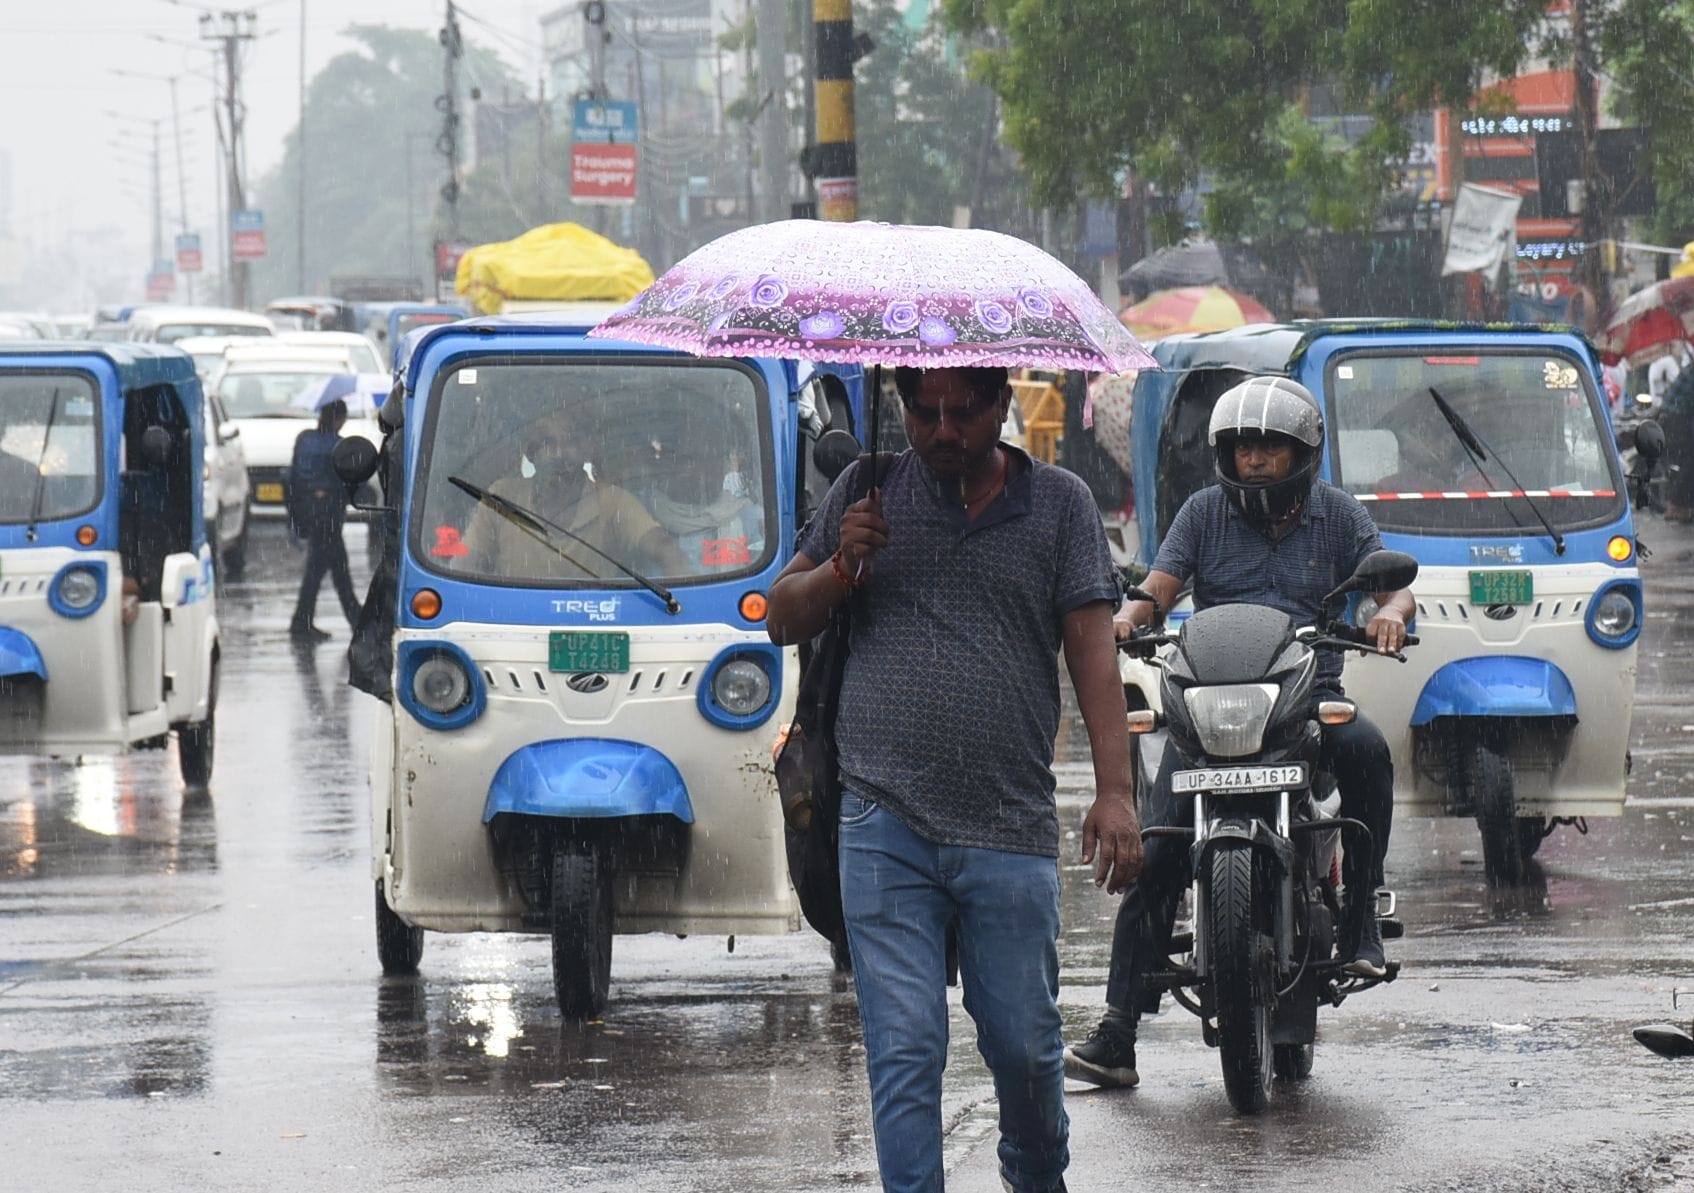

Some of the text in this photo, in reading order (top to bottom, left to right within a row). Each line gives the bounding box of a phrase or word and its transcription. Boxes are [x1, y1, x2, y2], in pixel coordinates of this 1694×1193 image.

[574, 154, 634, 169] Trauma
[574, 170, 634, 187] Surgery
[589, 613, 616, 621] PLUS
